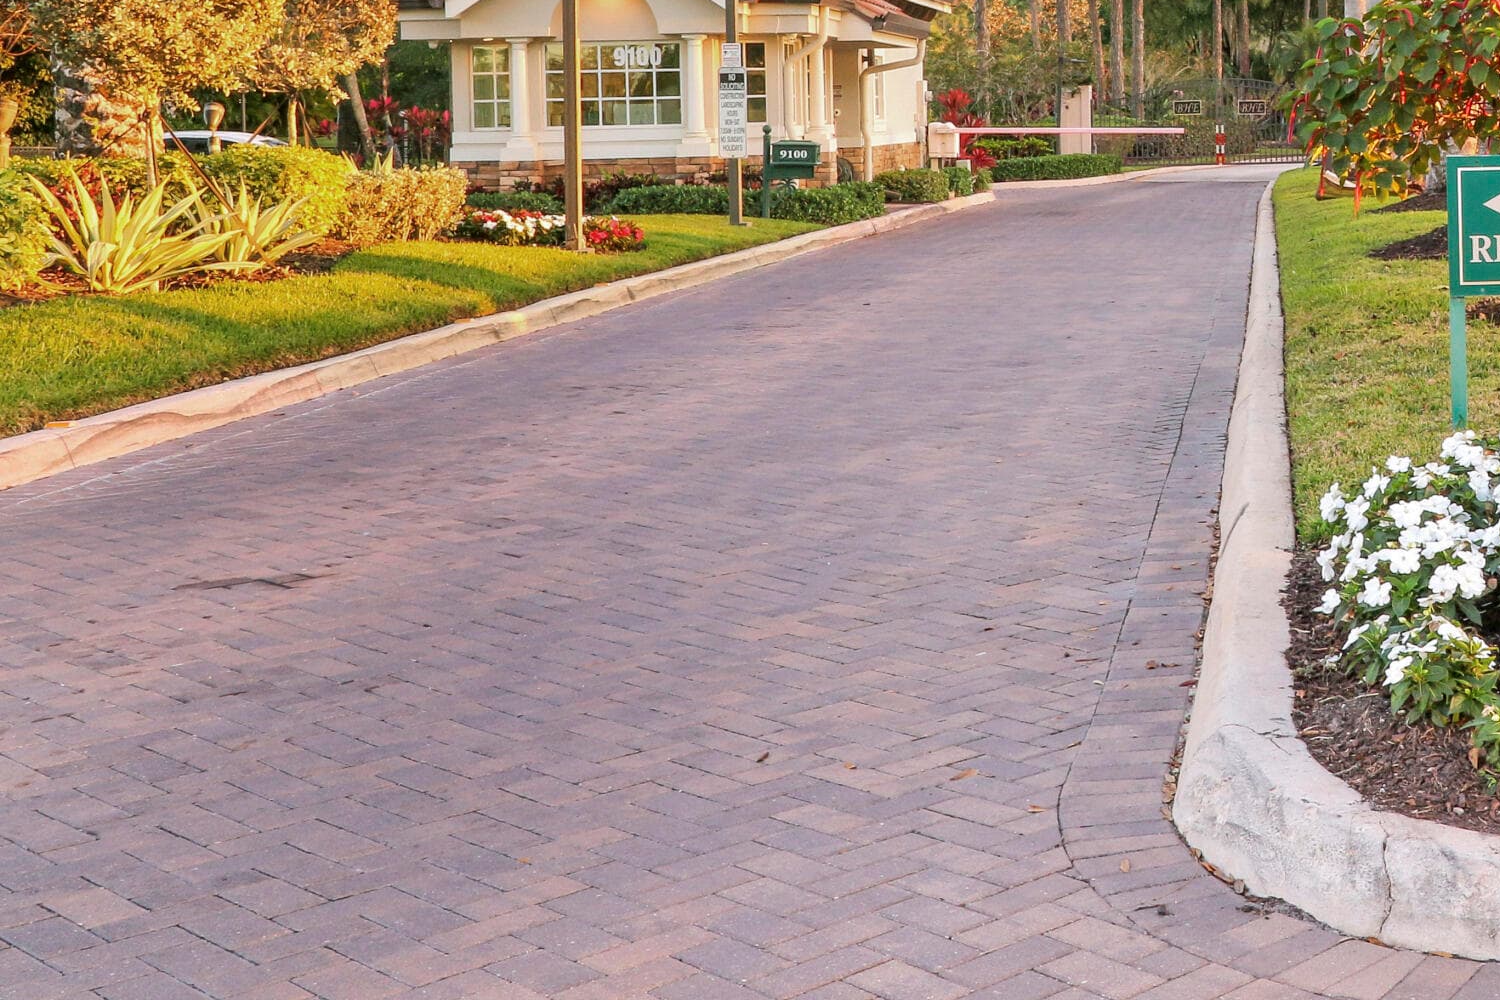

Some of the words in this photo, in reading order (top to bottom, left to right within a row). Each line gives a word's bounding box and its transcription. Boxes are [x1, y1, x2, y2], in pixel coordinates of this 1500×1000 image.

[613, 46, 662, 67] 9100
[728, 73, 736, 81] NO
[779, 149, 808, 159] 9100
